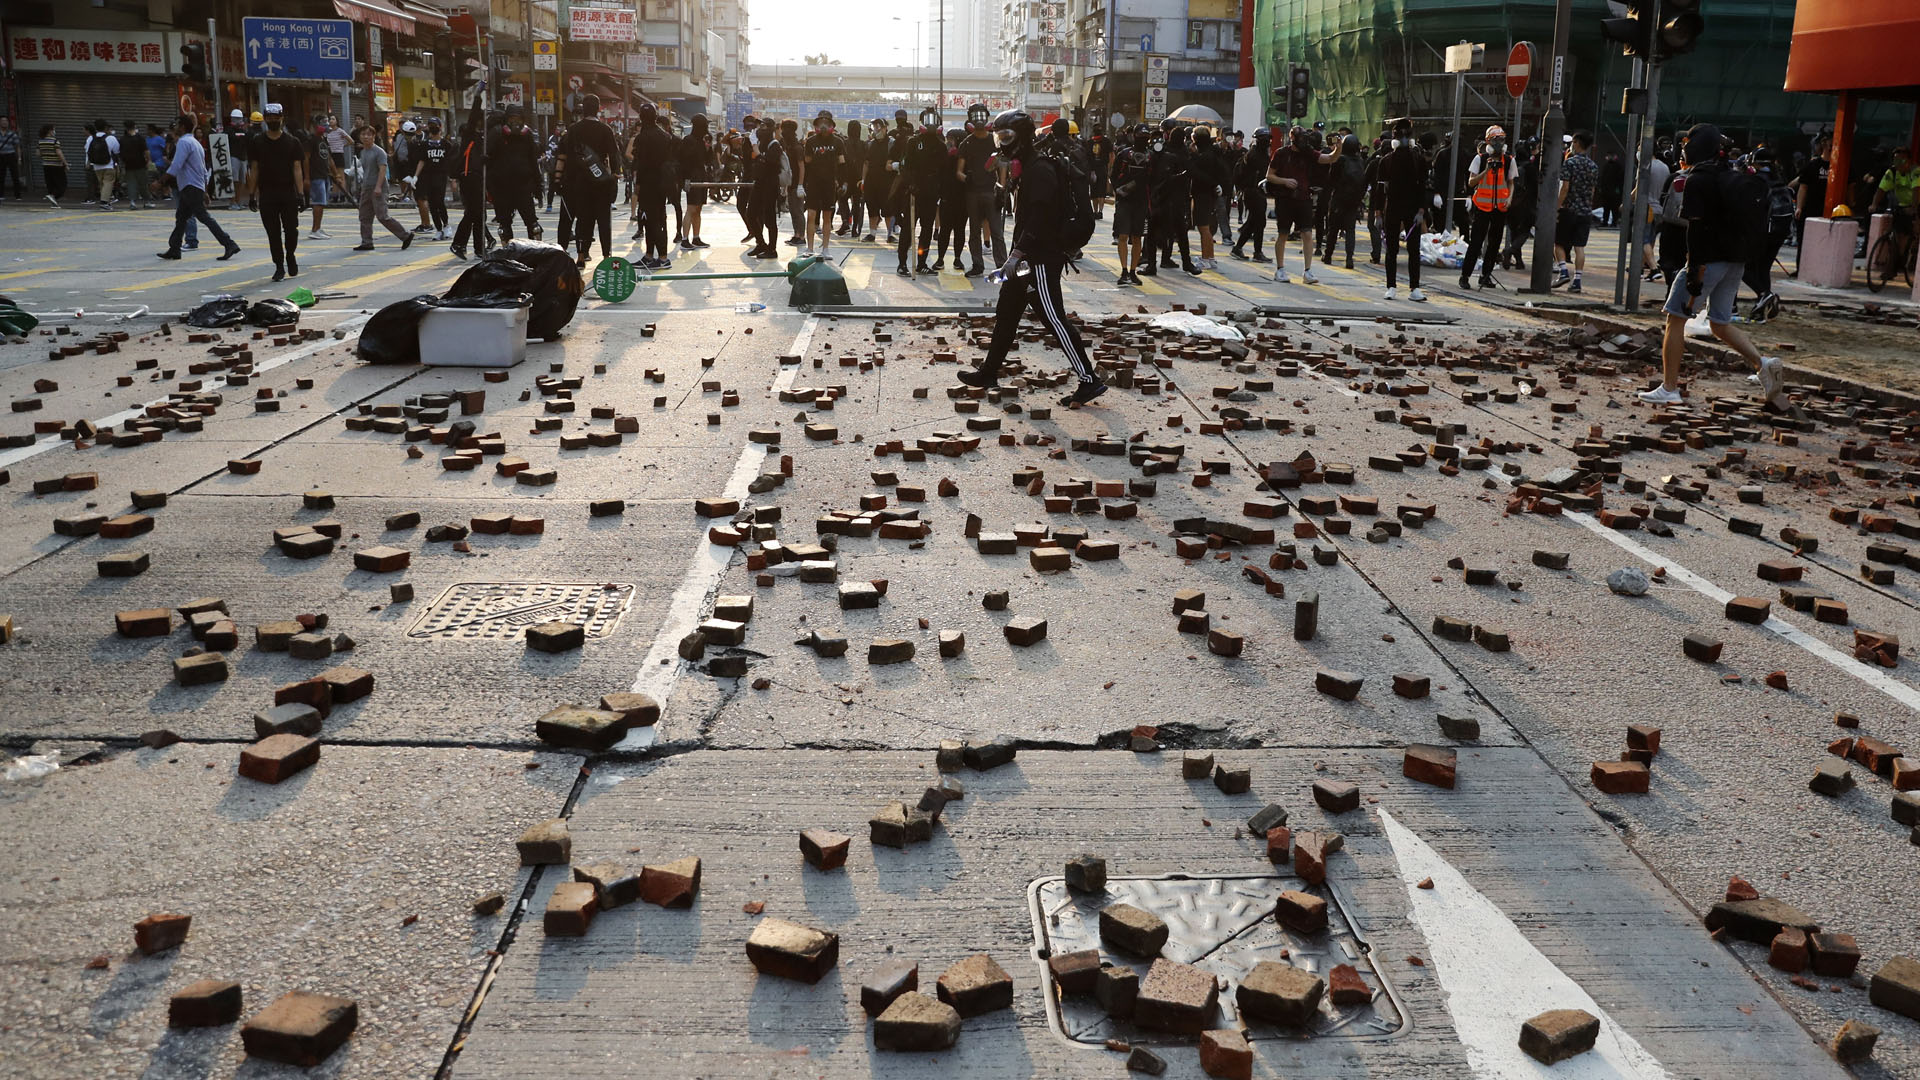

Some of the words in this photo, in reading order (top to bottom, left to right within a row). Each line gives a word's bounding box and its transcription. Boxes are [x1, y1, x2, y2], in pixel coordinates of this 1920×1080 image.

[262, 23, 286, 34] Hong
[290, 24, 313, 35] Kong
[14, 38, 161, 63] 連和燒味餐廳
[264, 37, 314, 50] 香港(西)
[596, 269, 606, 290] 79W
